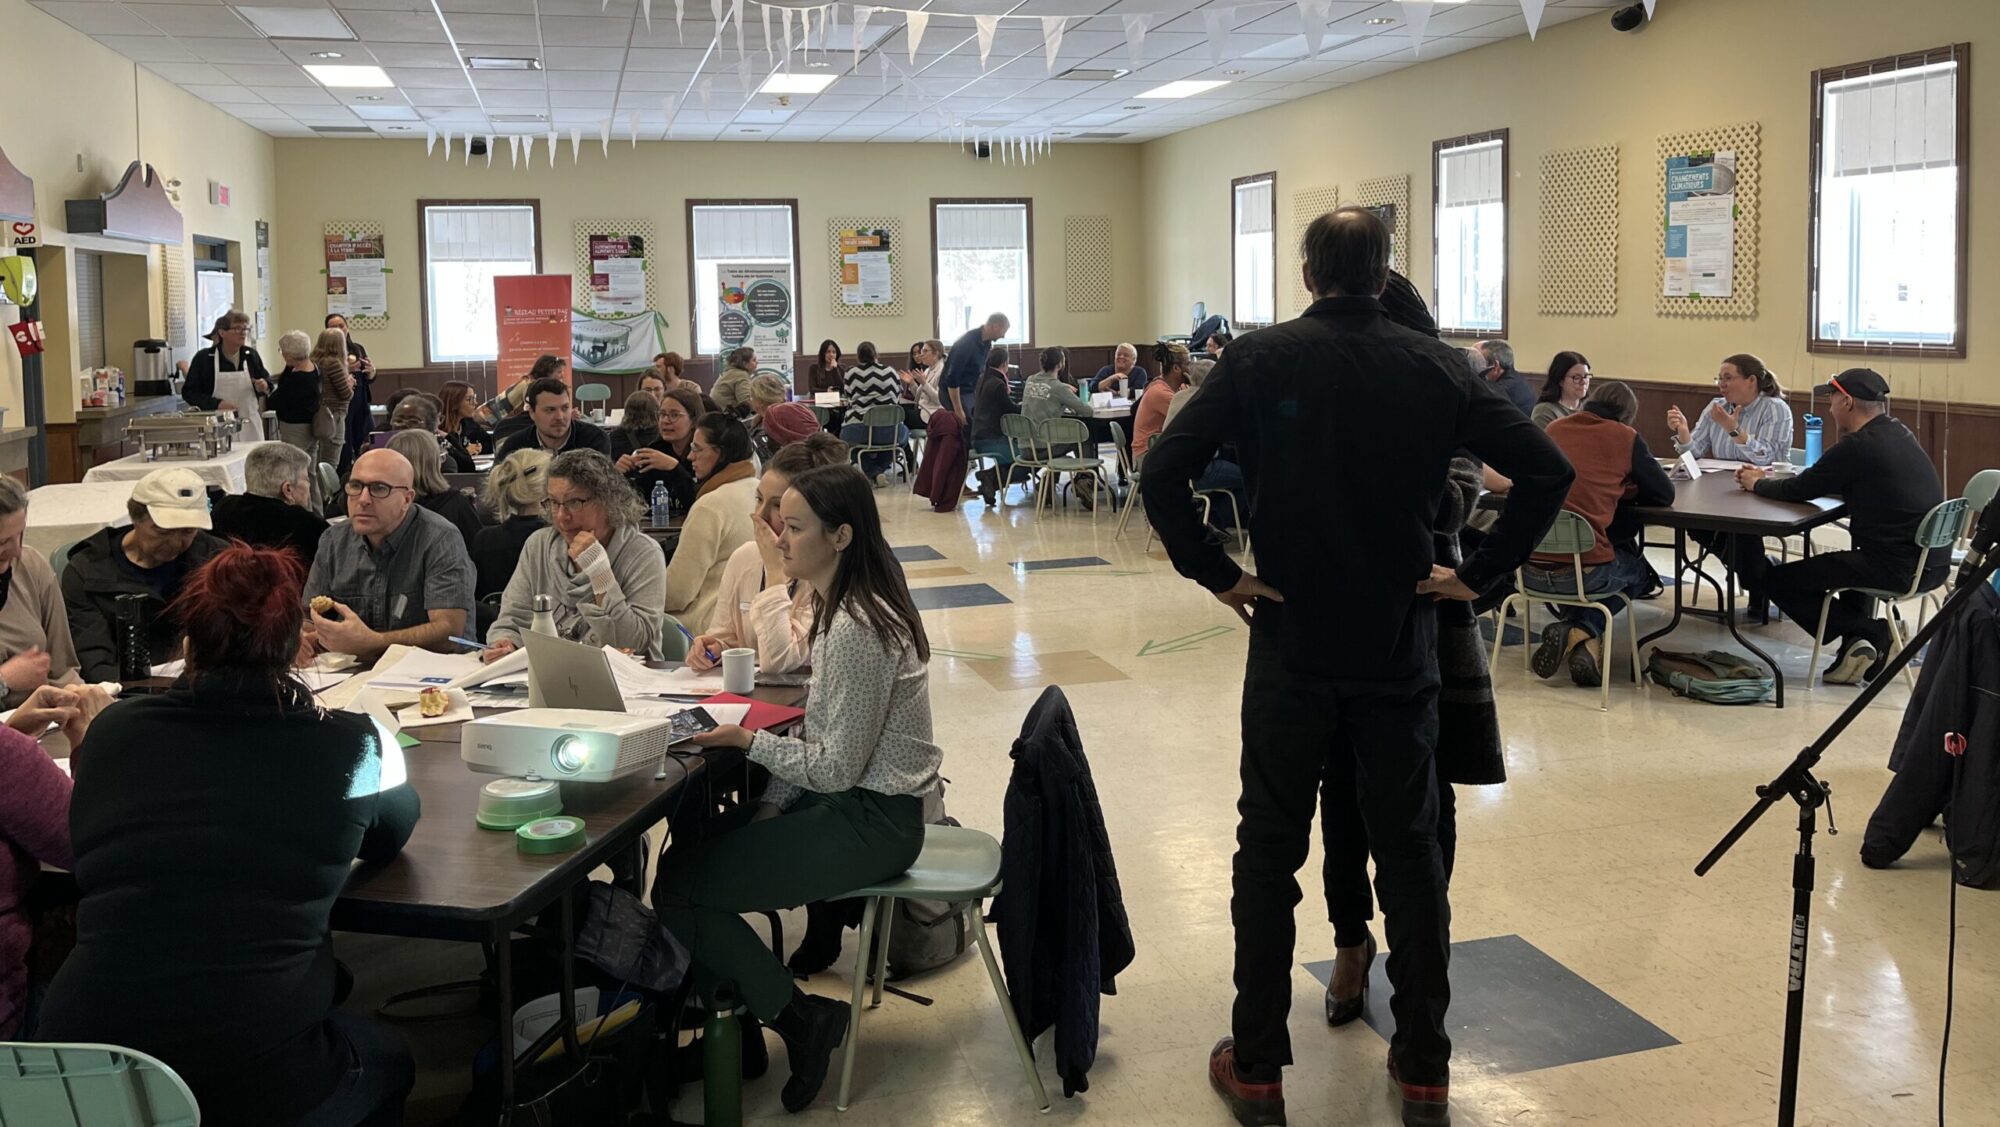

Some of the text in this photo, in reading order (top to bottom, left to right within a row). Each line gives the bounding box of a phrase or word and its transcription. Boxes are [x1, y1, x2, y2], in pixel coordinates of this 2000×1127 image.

[1671, 173, 1709, 183] CHANGEMENTS
[1671, 180, 1704, 190] CLIMATIQUES
[14, 236, 36, 245] AED
